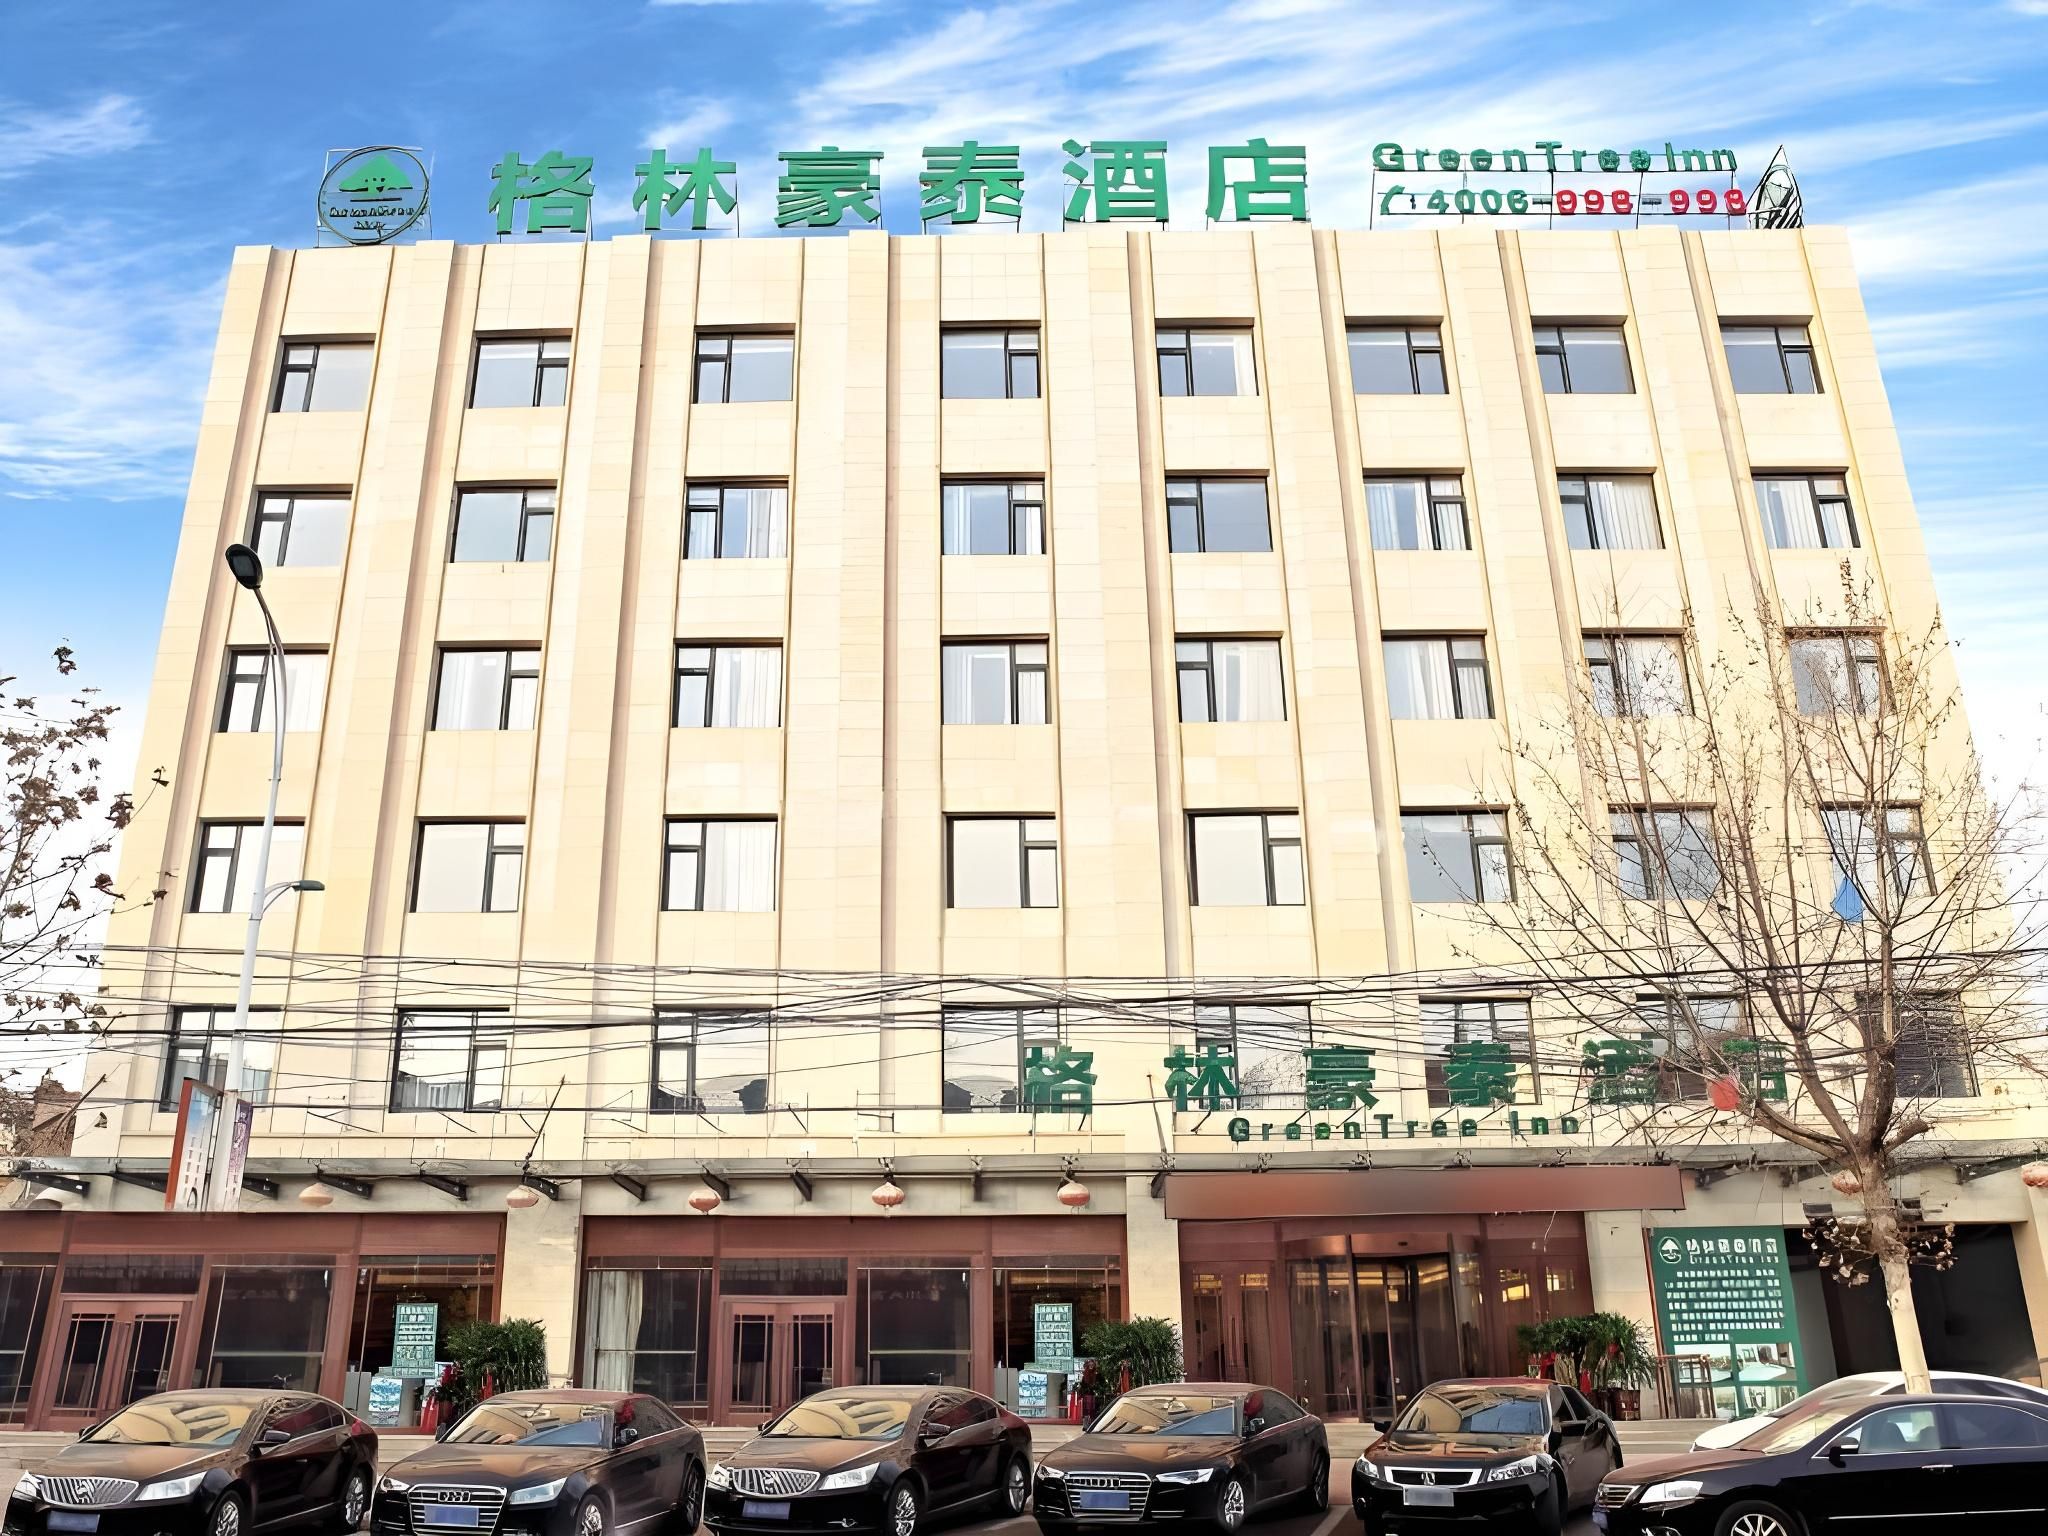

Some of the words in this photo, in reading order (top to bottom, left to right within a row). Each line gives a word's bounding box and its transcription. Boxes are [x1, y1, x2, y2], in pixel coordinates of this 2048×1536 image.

[488, 138, 1308, 234] 格林豪泰酒店
